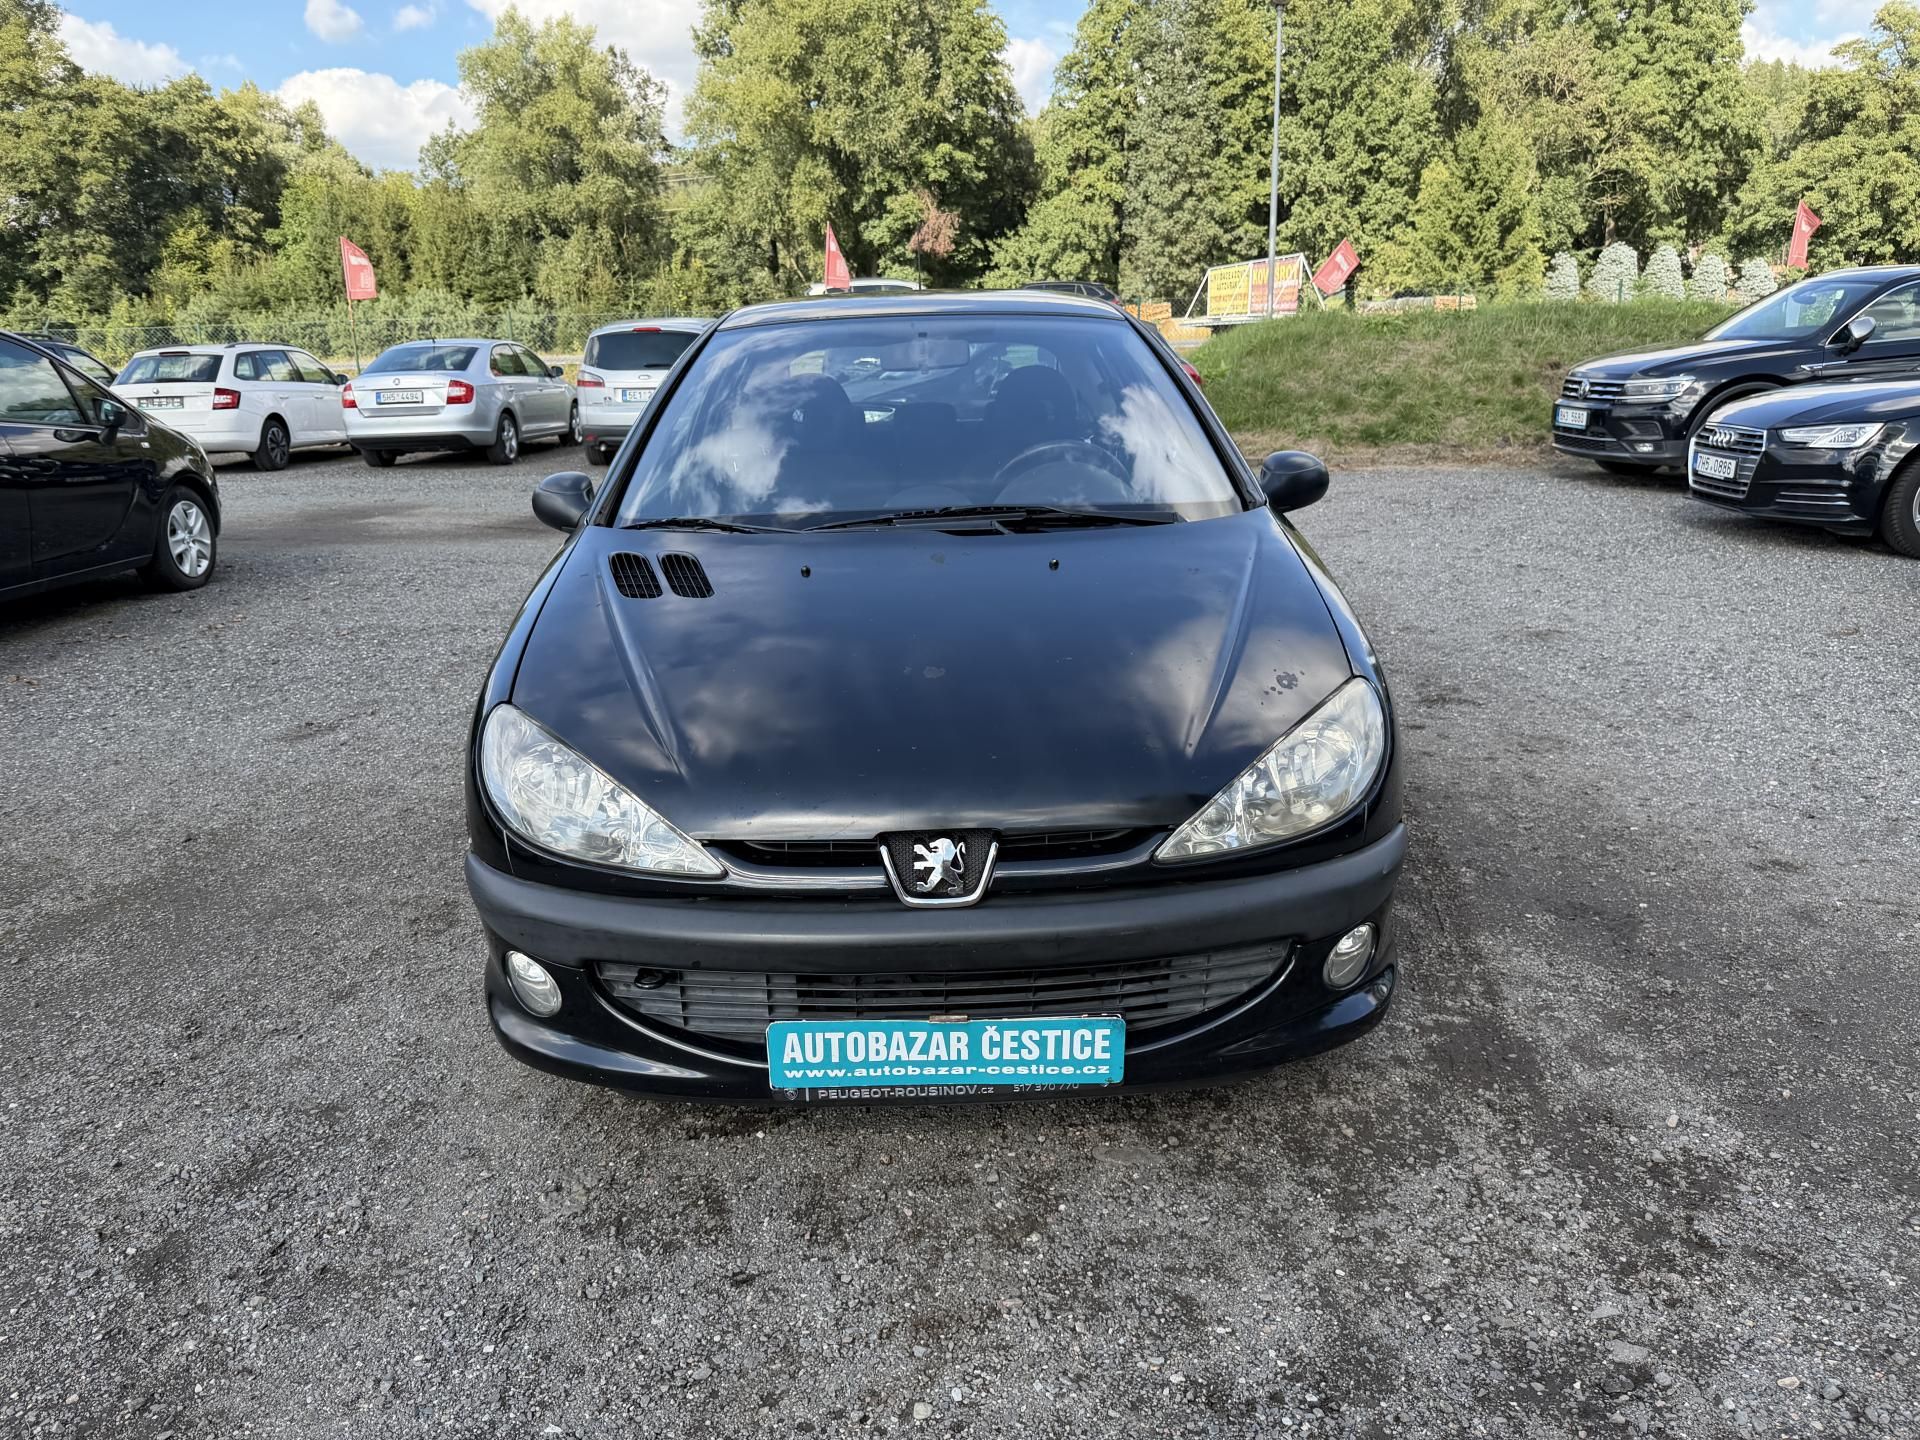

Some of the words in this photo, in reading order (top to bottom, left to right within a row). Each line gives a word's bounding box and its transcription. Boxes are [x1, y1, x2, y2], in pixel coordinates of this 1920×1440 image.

[401, 392, 419, 401] 4494
[1698, 453, 1710, 471] 7H5
[1713, 459, 1732, 475] 0886
[783, 1030, 969, 1064] AUTOBAZAR
[981, 1025, 1111, 1061] ČESTICE
[784, 1064, 1110, 1079] www.autobazar-cestice.cz
